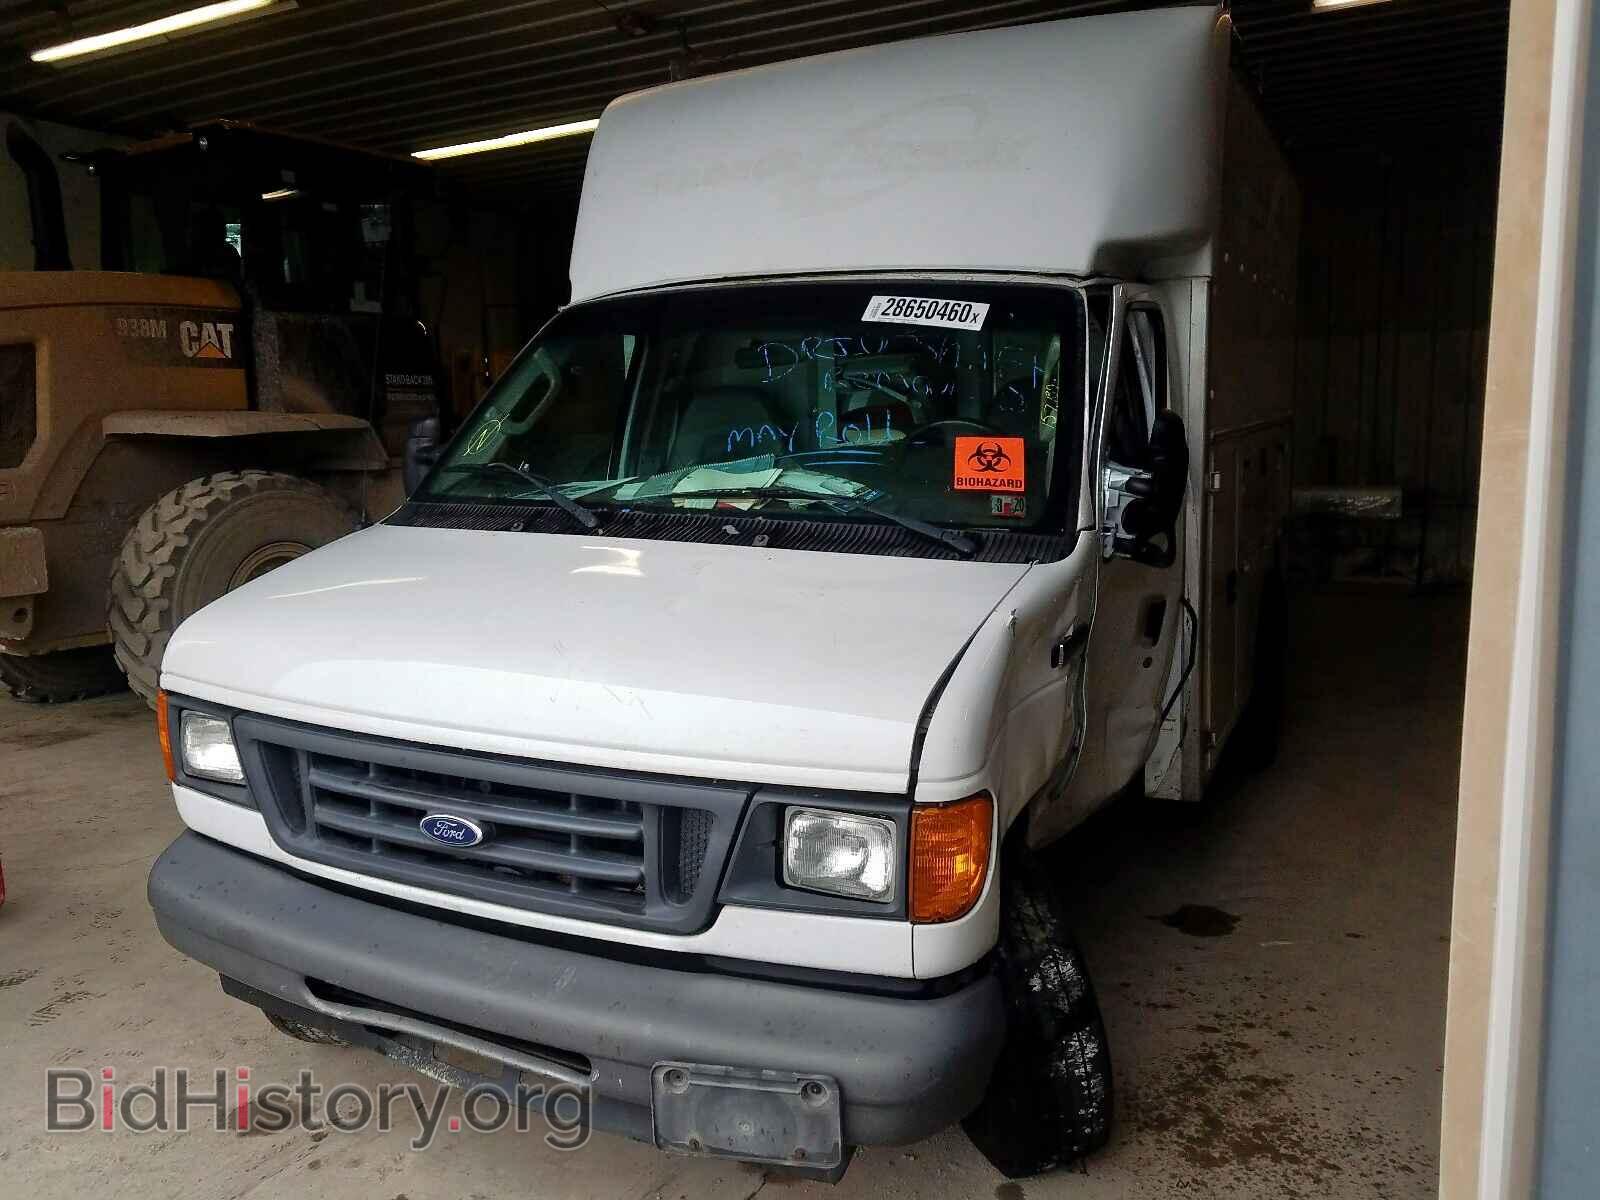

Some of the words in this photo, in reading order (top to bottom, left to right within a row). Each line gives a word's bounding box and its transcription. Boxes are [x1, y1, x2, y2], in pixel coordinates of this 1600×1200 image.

[180, 320, 235, 359] CAT
[956, 477, 1023, 489] BIOHAZARD
[433, 820, 466, 840] Ford
